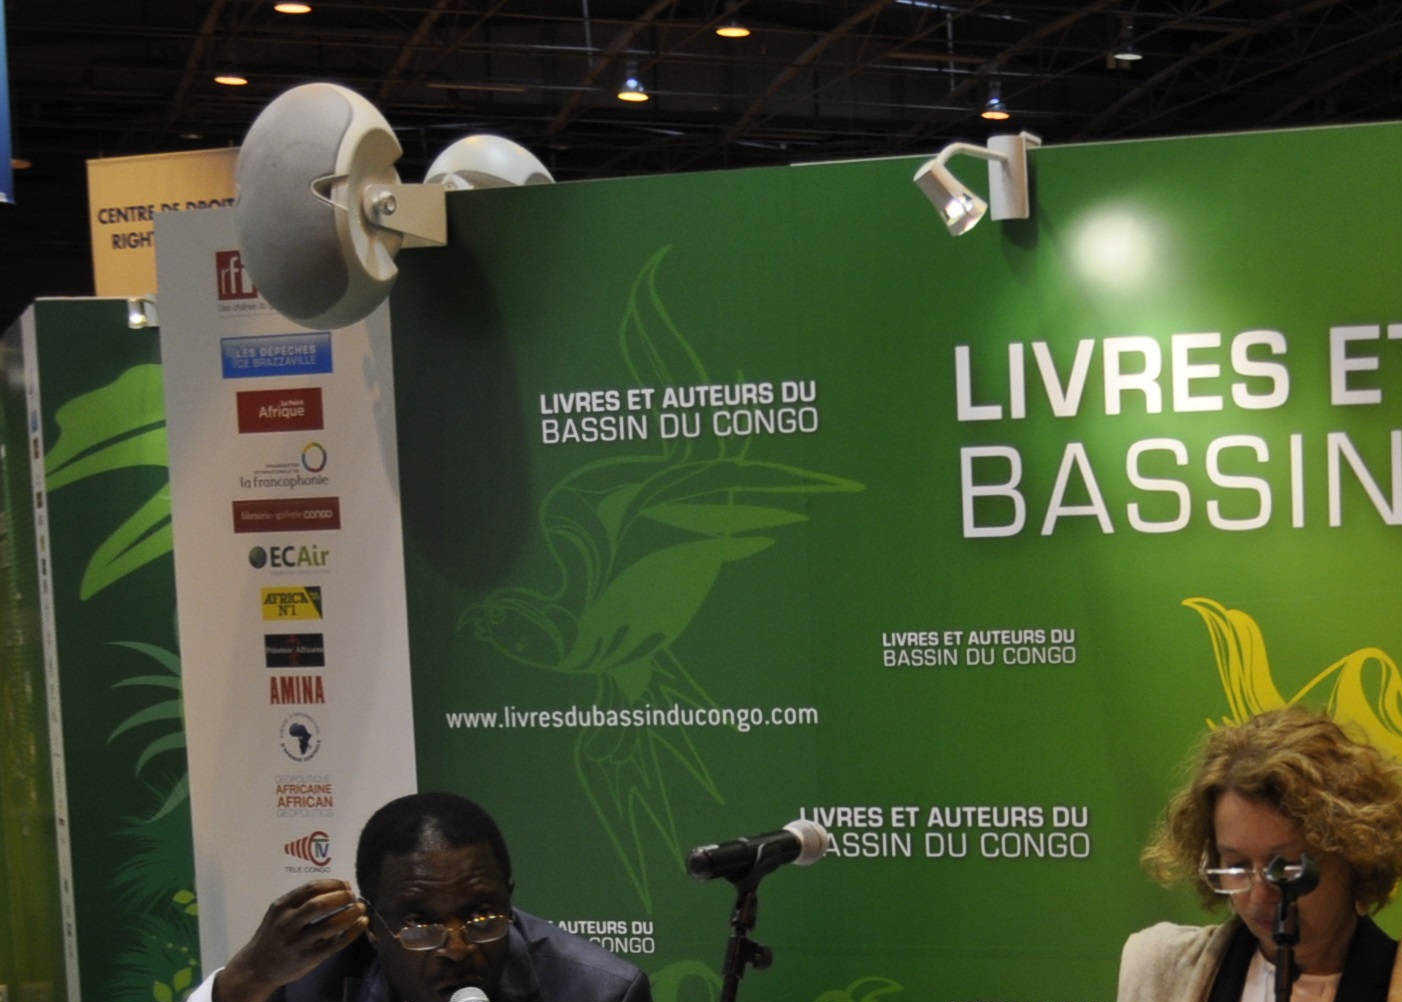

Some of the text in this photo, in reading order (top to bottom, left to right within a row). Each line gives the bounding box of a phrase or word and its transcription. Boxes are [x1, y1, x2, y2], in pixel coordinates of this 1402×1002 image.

[98, 204, 154, 224] CENTRE
[237, 347, 256, 358] LES
[954, 329, 1290, 421] LIVRES
[540, 380, 816, 414] LIVRES ET AUTEURS DU
[259, 405, 305, 419] Afrique
[542, 407, 819, 444] BASSIN DU CONGO
[239, 475, 329, 490] la francophonie
[270, 544, 330, 568] ECAir
[264, 592, 310, 605] AFRICA
[882, 629, 1075, 647] LIVRES ET AUTEURS DU
[883, 646, 1077, 667] BASSIN DU CONGO
[270, 676, 325, 705] AMINA
[446, 704, 819, 732] www.livresdubassinducongo.com
[276, 784, 332, 794] AFRICAINE
[277, 796, 333, 808] AFRICAN
[891, 807, 920, 827] ET
[927, 806, 1044, 828] AUTEURS
[1052, 806, 1088, 828] DU
[823, 832, 1090, 858] ASSIN DU CONGO
[632, 921, 653, 935] DU
